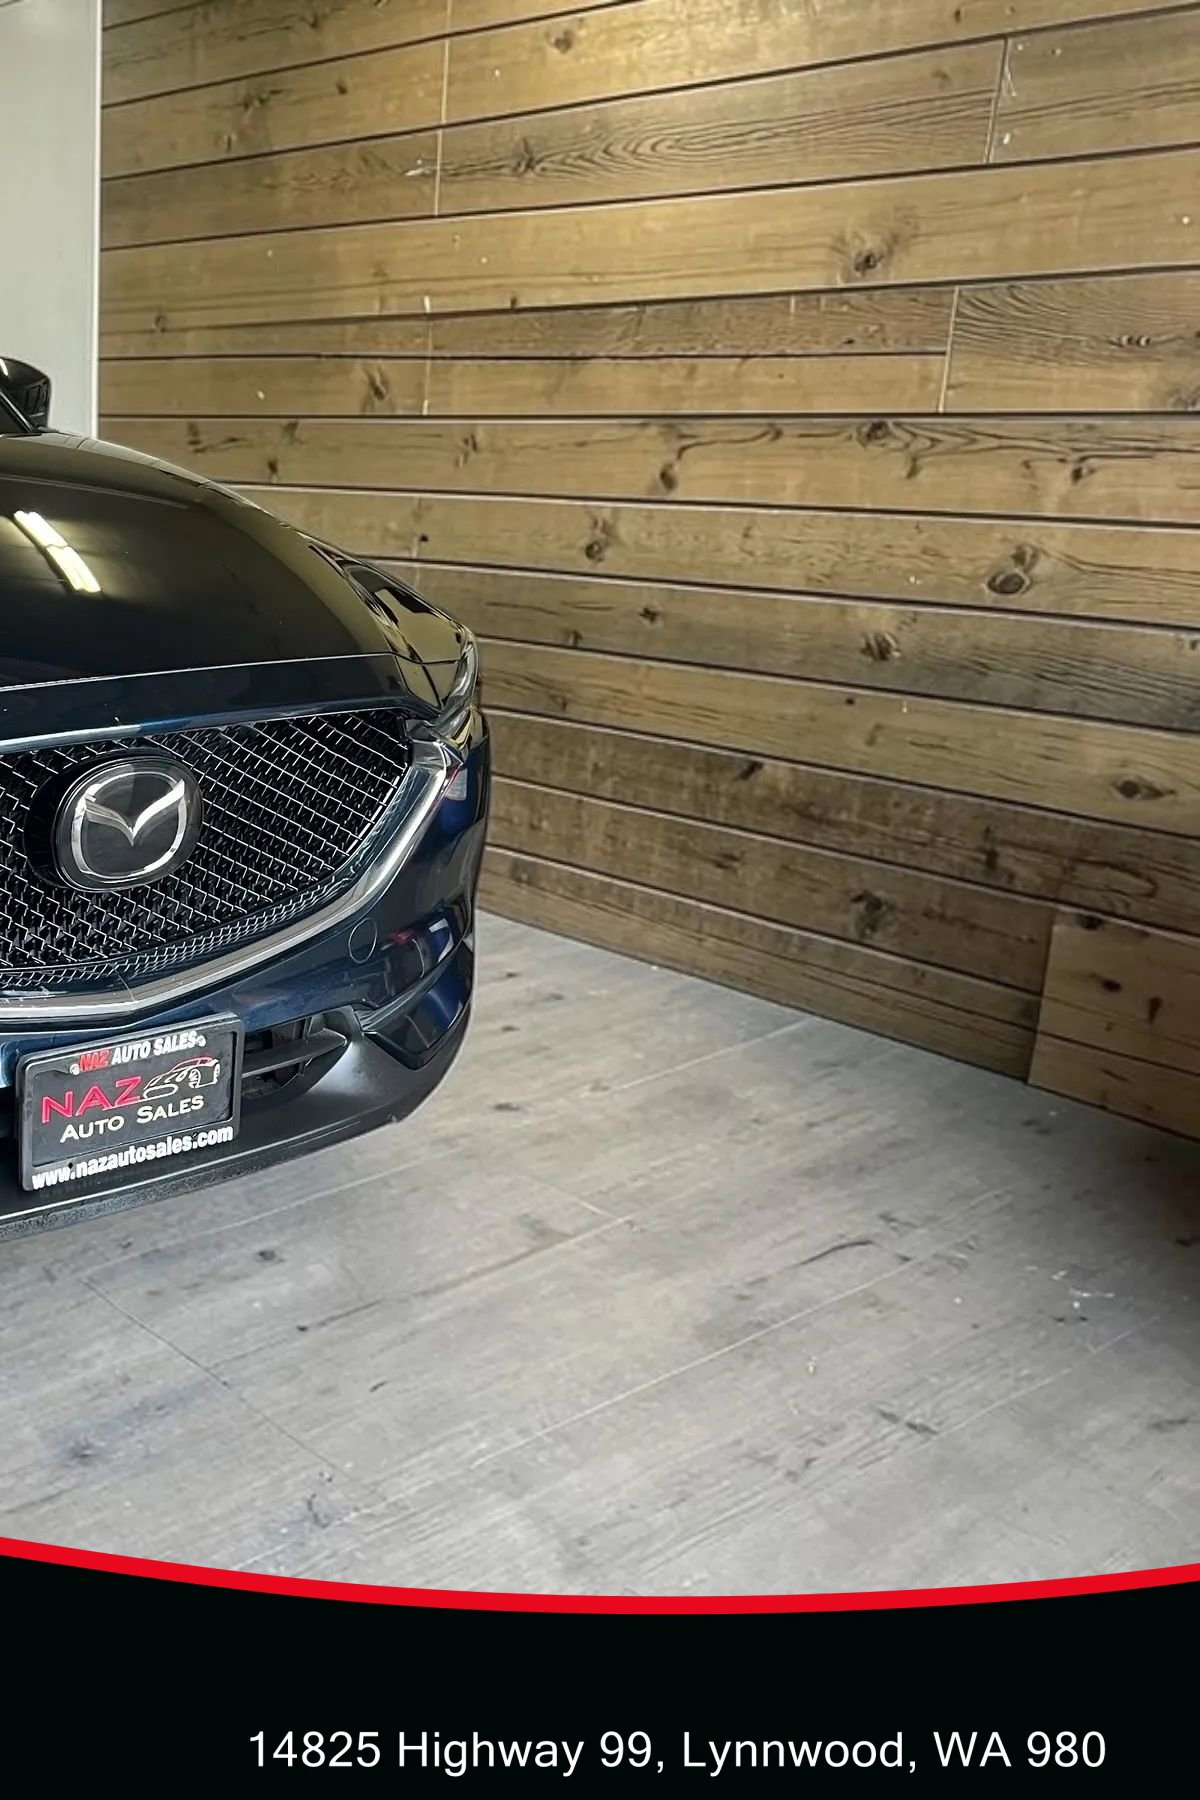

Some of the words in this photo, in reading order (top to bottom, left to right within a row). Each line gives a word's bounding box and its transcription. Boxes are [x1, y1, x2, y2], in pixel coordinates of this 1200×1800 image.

[111, 1041, 151, 1065] AUTO
[153, 1030, 197, 1056] SALES
[42, 1076, 142, 1123] NAZ
[59, 1115, 125, 1143] AUTO
[136, 1095, 204, 1124] SALES
[32, 1125, 233, 1190] www.nazautosales.com
